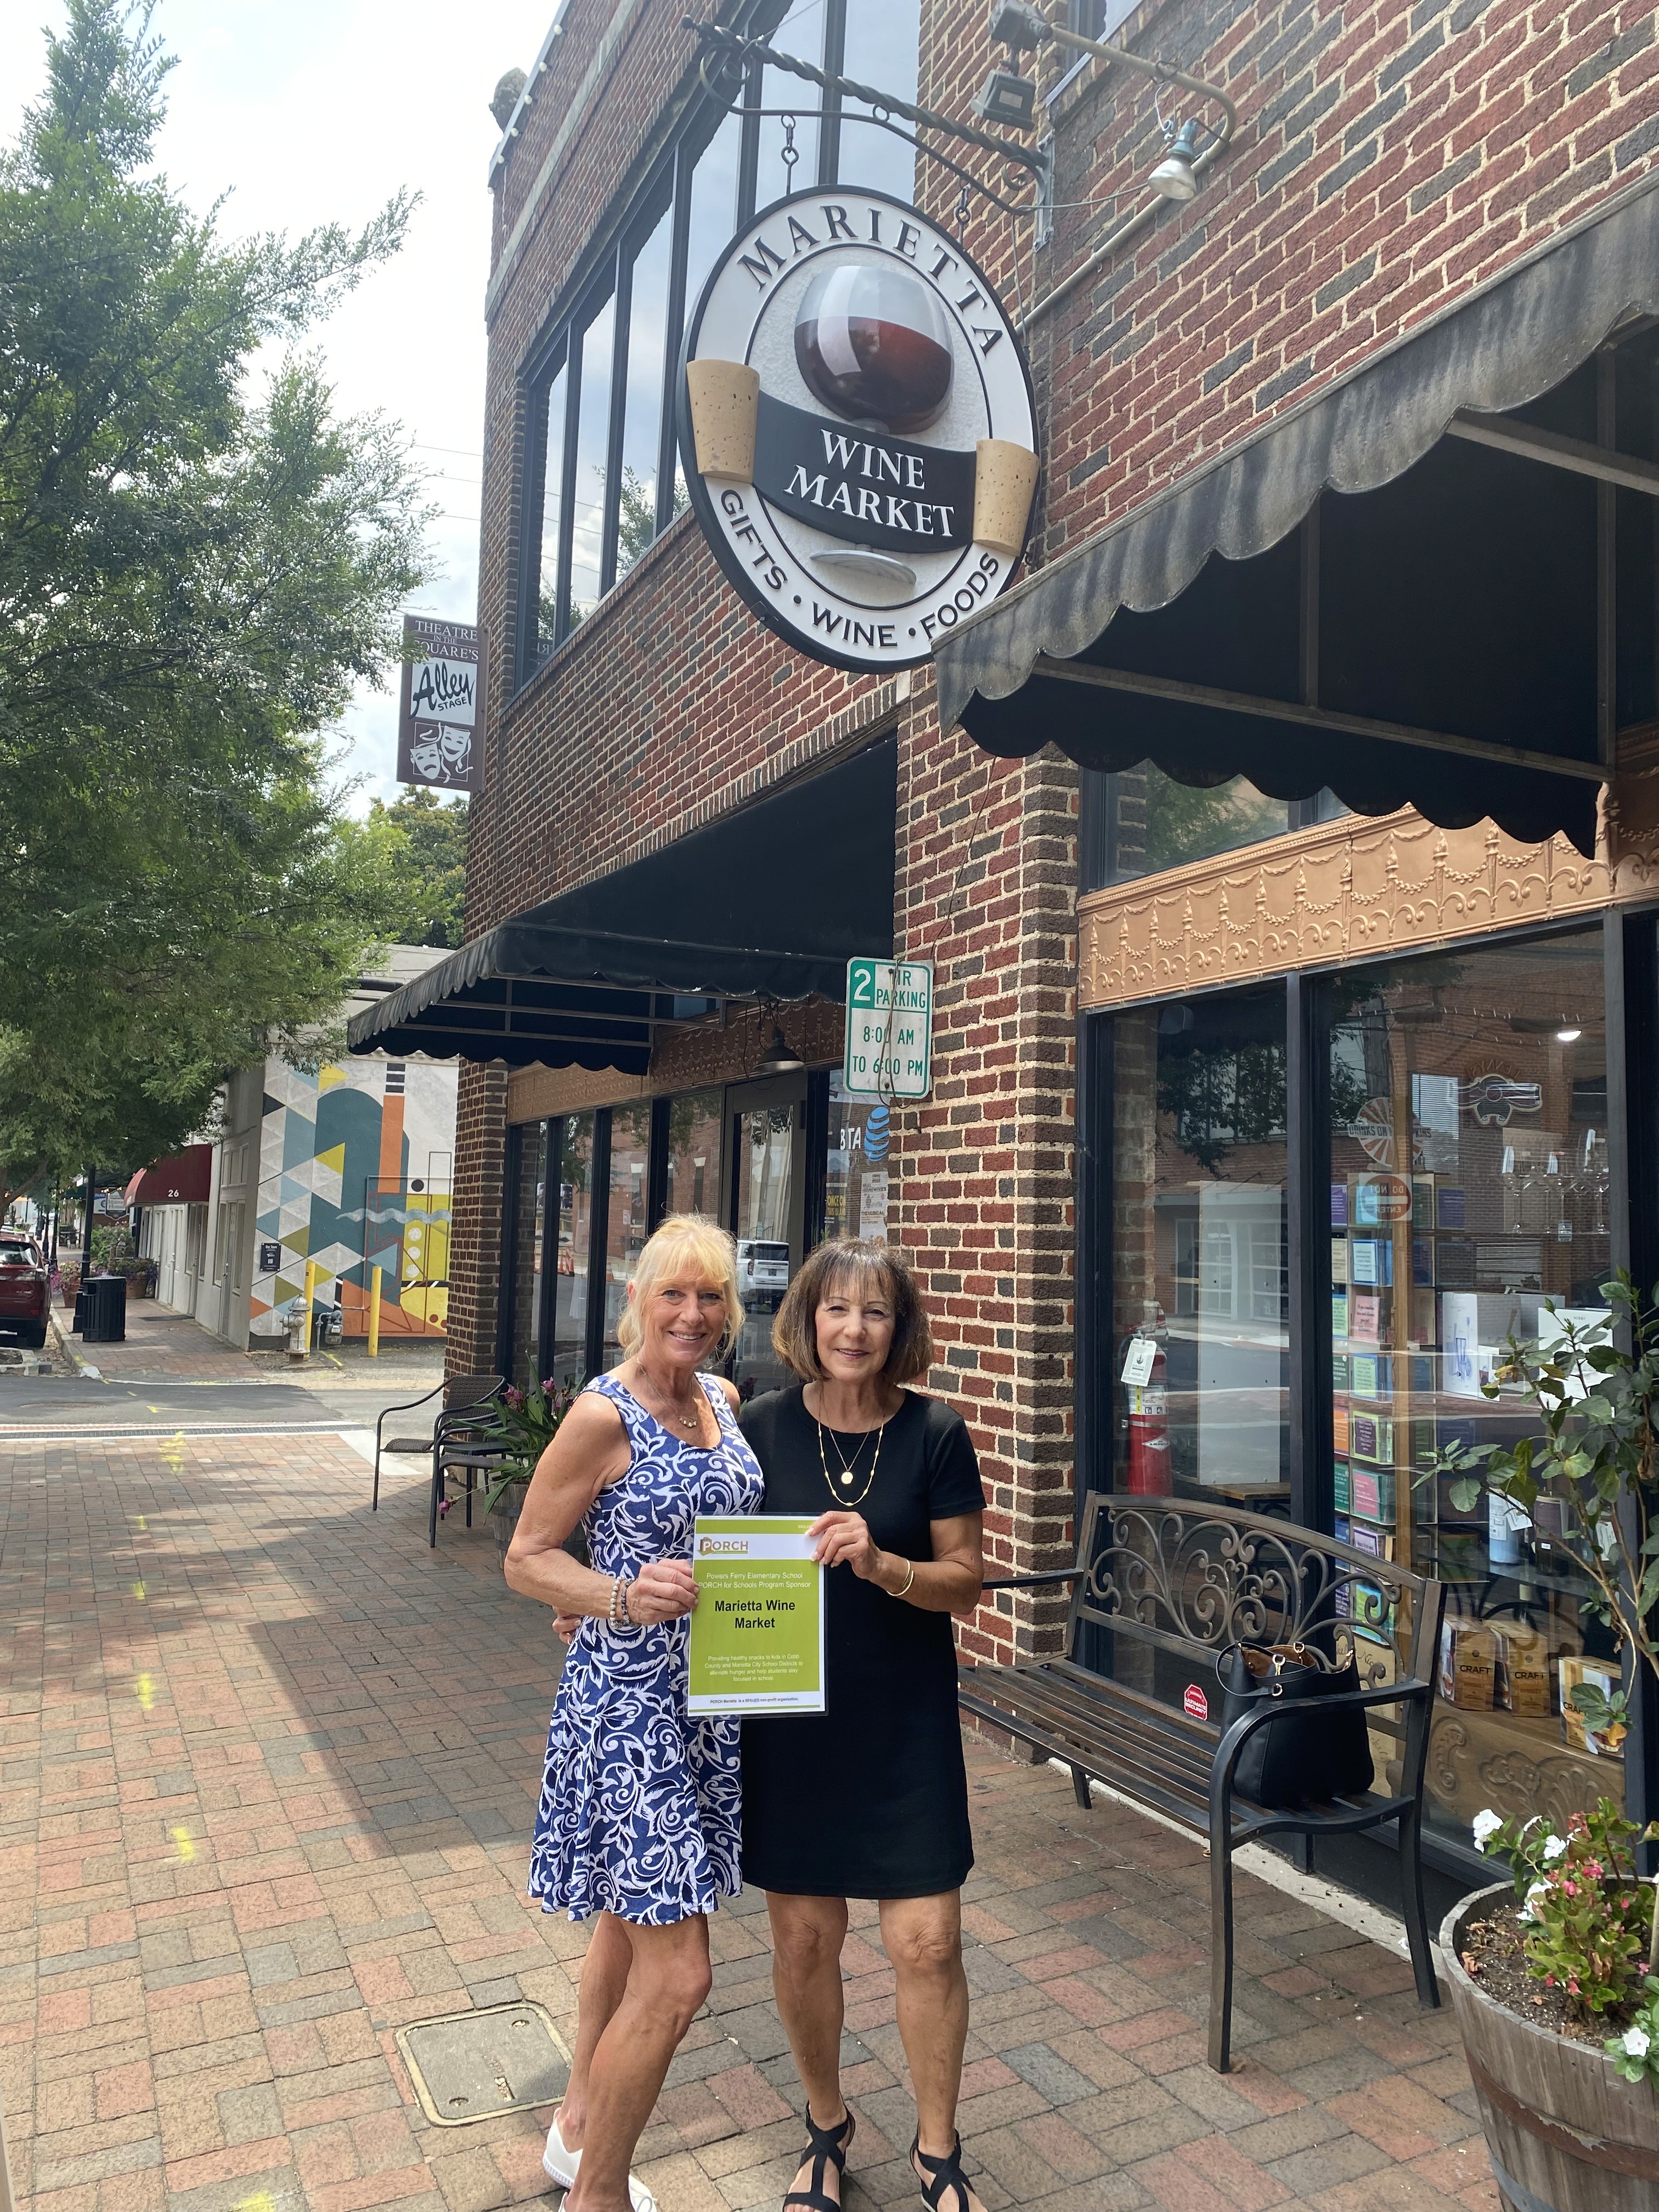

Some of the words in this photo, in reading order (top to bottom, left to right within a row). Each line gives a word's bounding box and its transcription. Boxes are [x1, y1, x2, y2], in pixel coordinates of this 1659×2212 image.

[737, 205, 1003, 357] MARIETTA
[820, 428, 926, 491] WINE
[783, 465, 954, 538] MARKET
[720, 489, 788, 591] GIFTS
[918, 551, 1000, 641] FOODS
[415, 620, 478, 640] THEATRE
[810, 601, 898, 648] WINE
[443, 636, 457, 645] THE
[408, 661, 475, 720] Alley
[437, 696, 467, 712] STAGE
[854, 968, 871, 1001] 2
[876, 989, 926, 1008] PARKING
[863, 1026, 890, 1043] 8:00
[898, 1029, 914, 1045] AM
[853, 1056, 866, 1073] TO
[873, 1058, 900, 1075] 6:00
[907, 1059, 923, 1076] PM
[1349, 1125, 1375, 1136] DRINKS
[168, 1189, 179, 1198] 26
[703, 1541, 748, 1552] PORCH
[759, 1582, 785, 1590] Program
[786, 1581, 811, 1589] Sponsor
[715, 1600, 762, 1612] Marietta
[766, 1599, 796, 1611] Wine
[735, 1617, 775, 1629] Market
[1460, 1664, 1491, 1675] CRAFT
[1514, 1672, 1544, 1680] CRAFT
[1186, 1697, 1206, 1711] ULTIMATE
